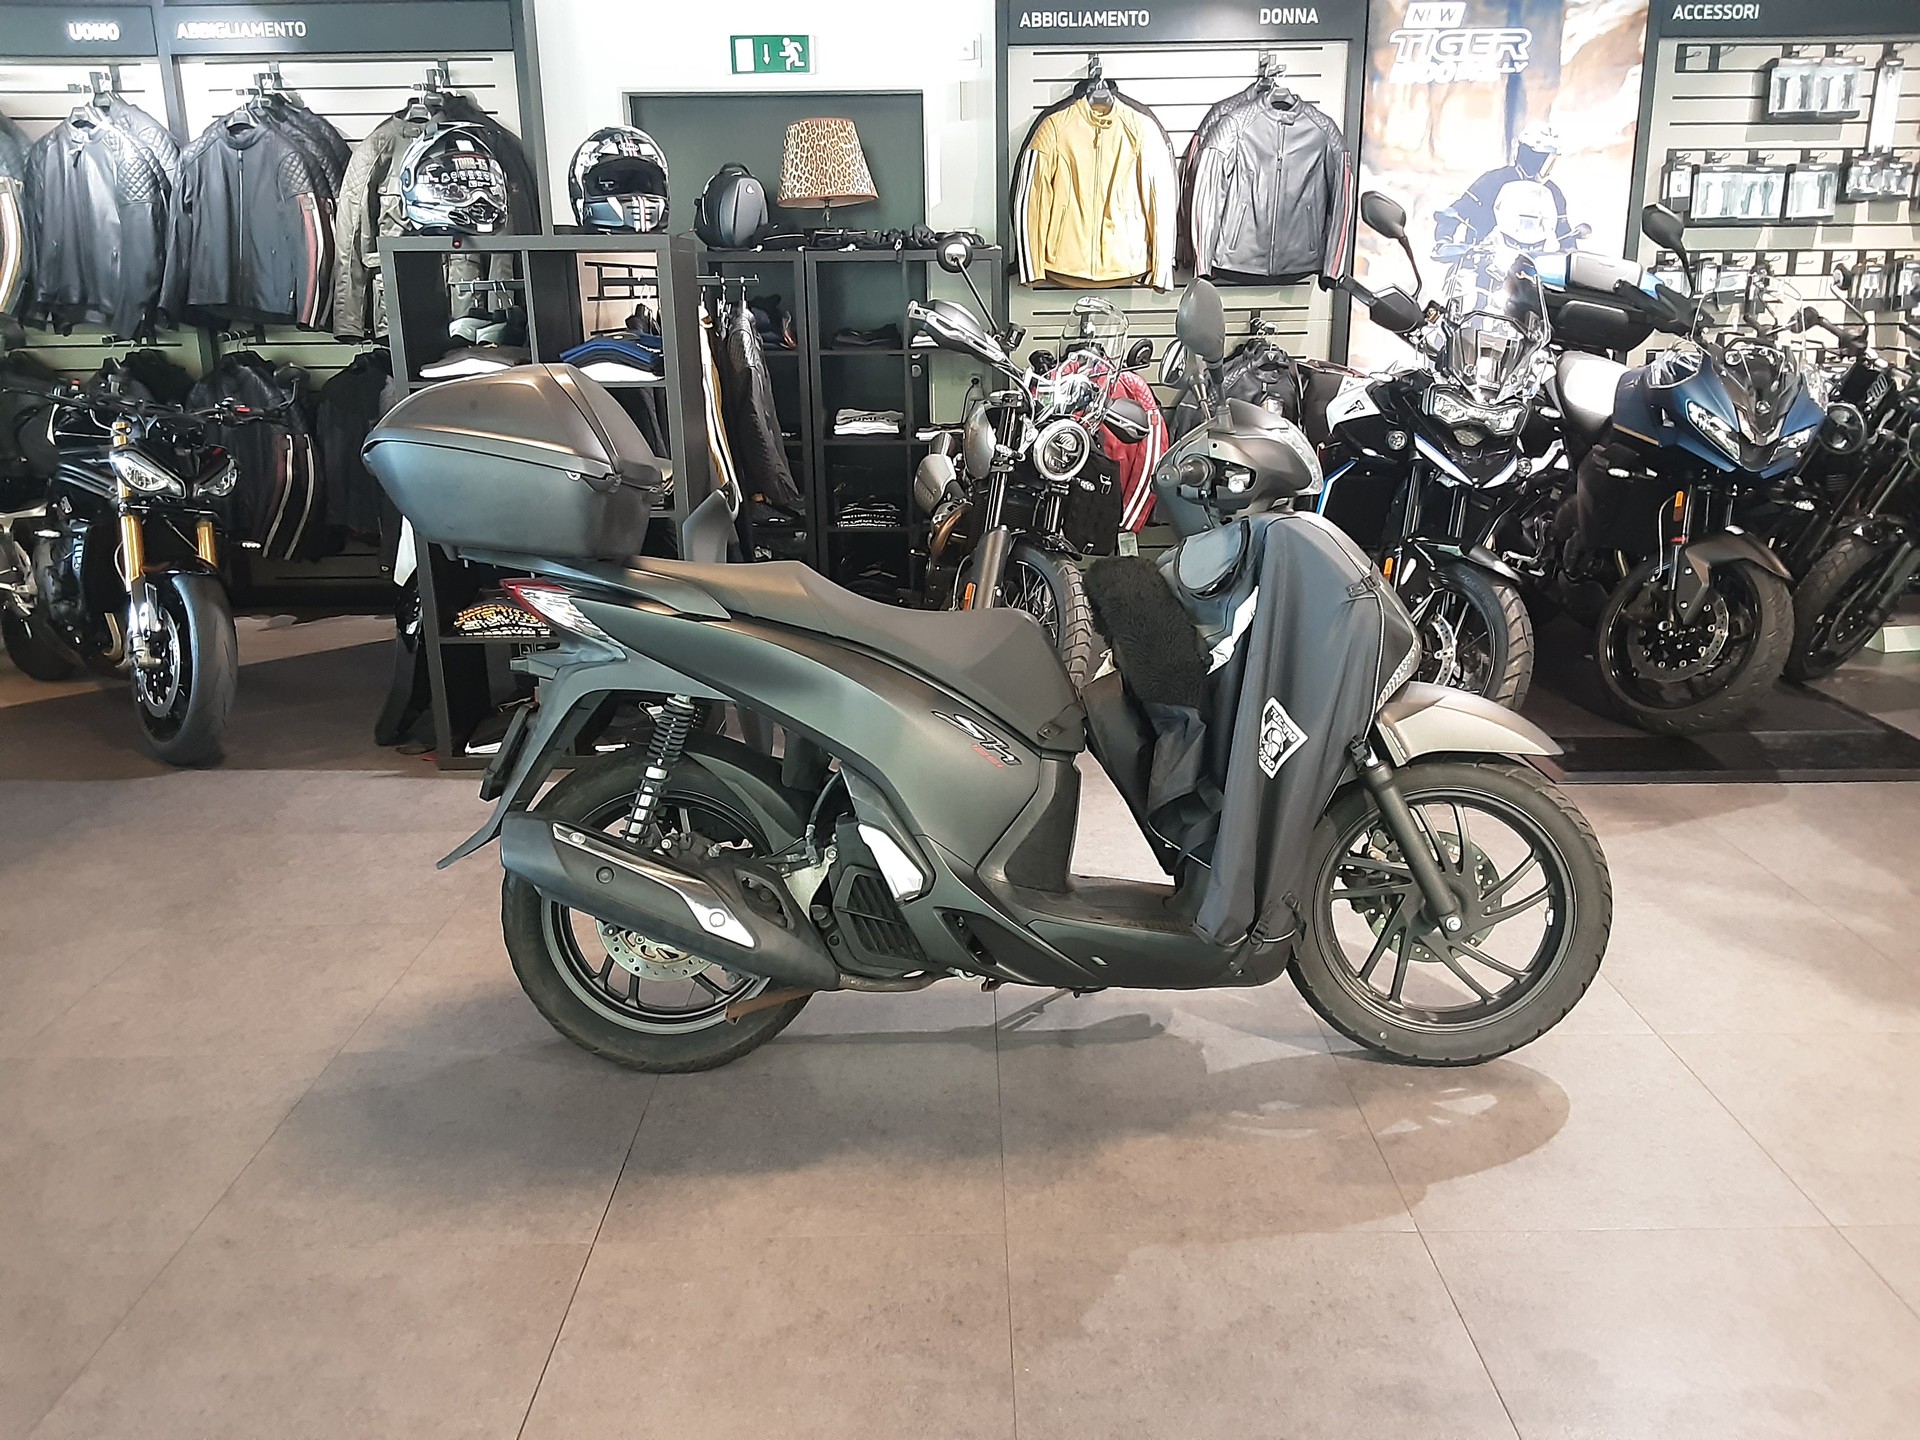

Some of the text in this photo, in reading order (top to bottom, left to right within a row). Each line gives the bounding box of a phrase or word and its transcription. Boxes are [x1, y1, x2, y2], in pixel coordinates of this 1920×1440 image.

[1019, 10, 1150, 28] ABBIGLIAMENTO
[1259, 8, 1319, 25] DONNA
[1672, 3, 1760, 20] ACCESSORI
[68, 23, 121, 41] UOMO
[176, 21, 307, 40] ABBIGLIAMENTO
[1389, 28, 1533, 63] TIGER
